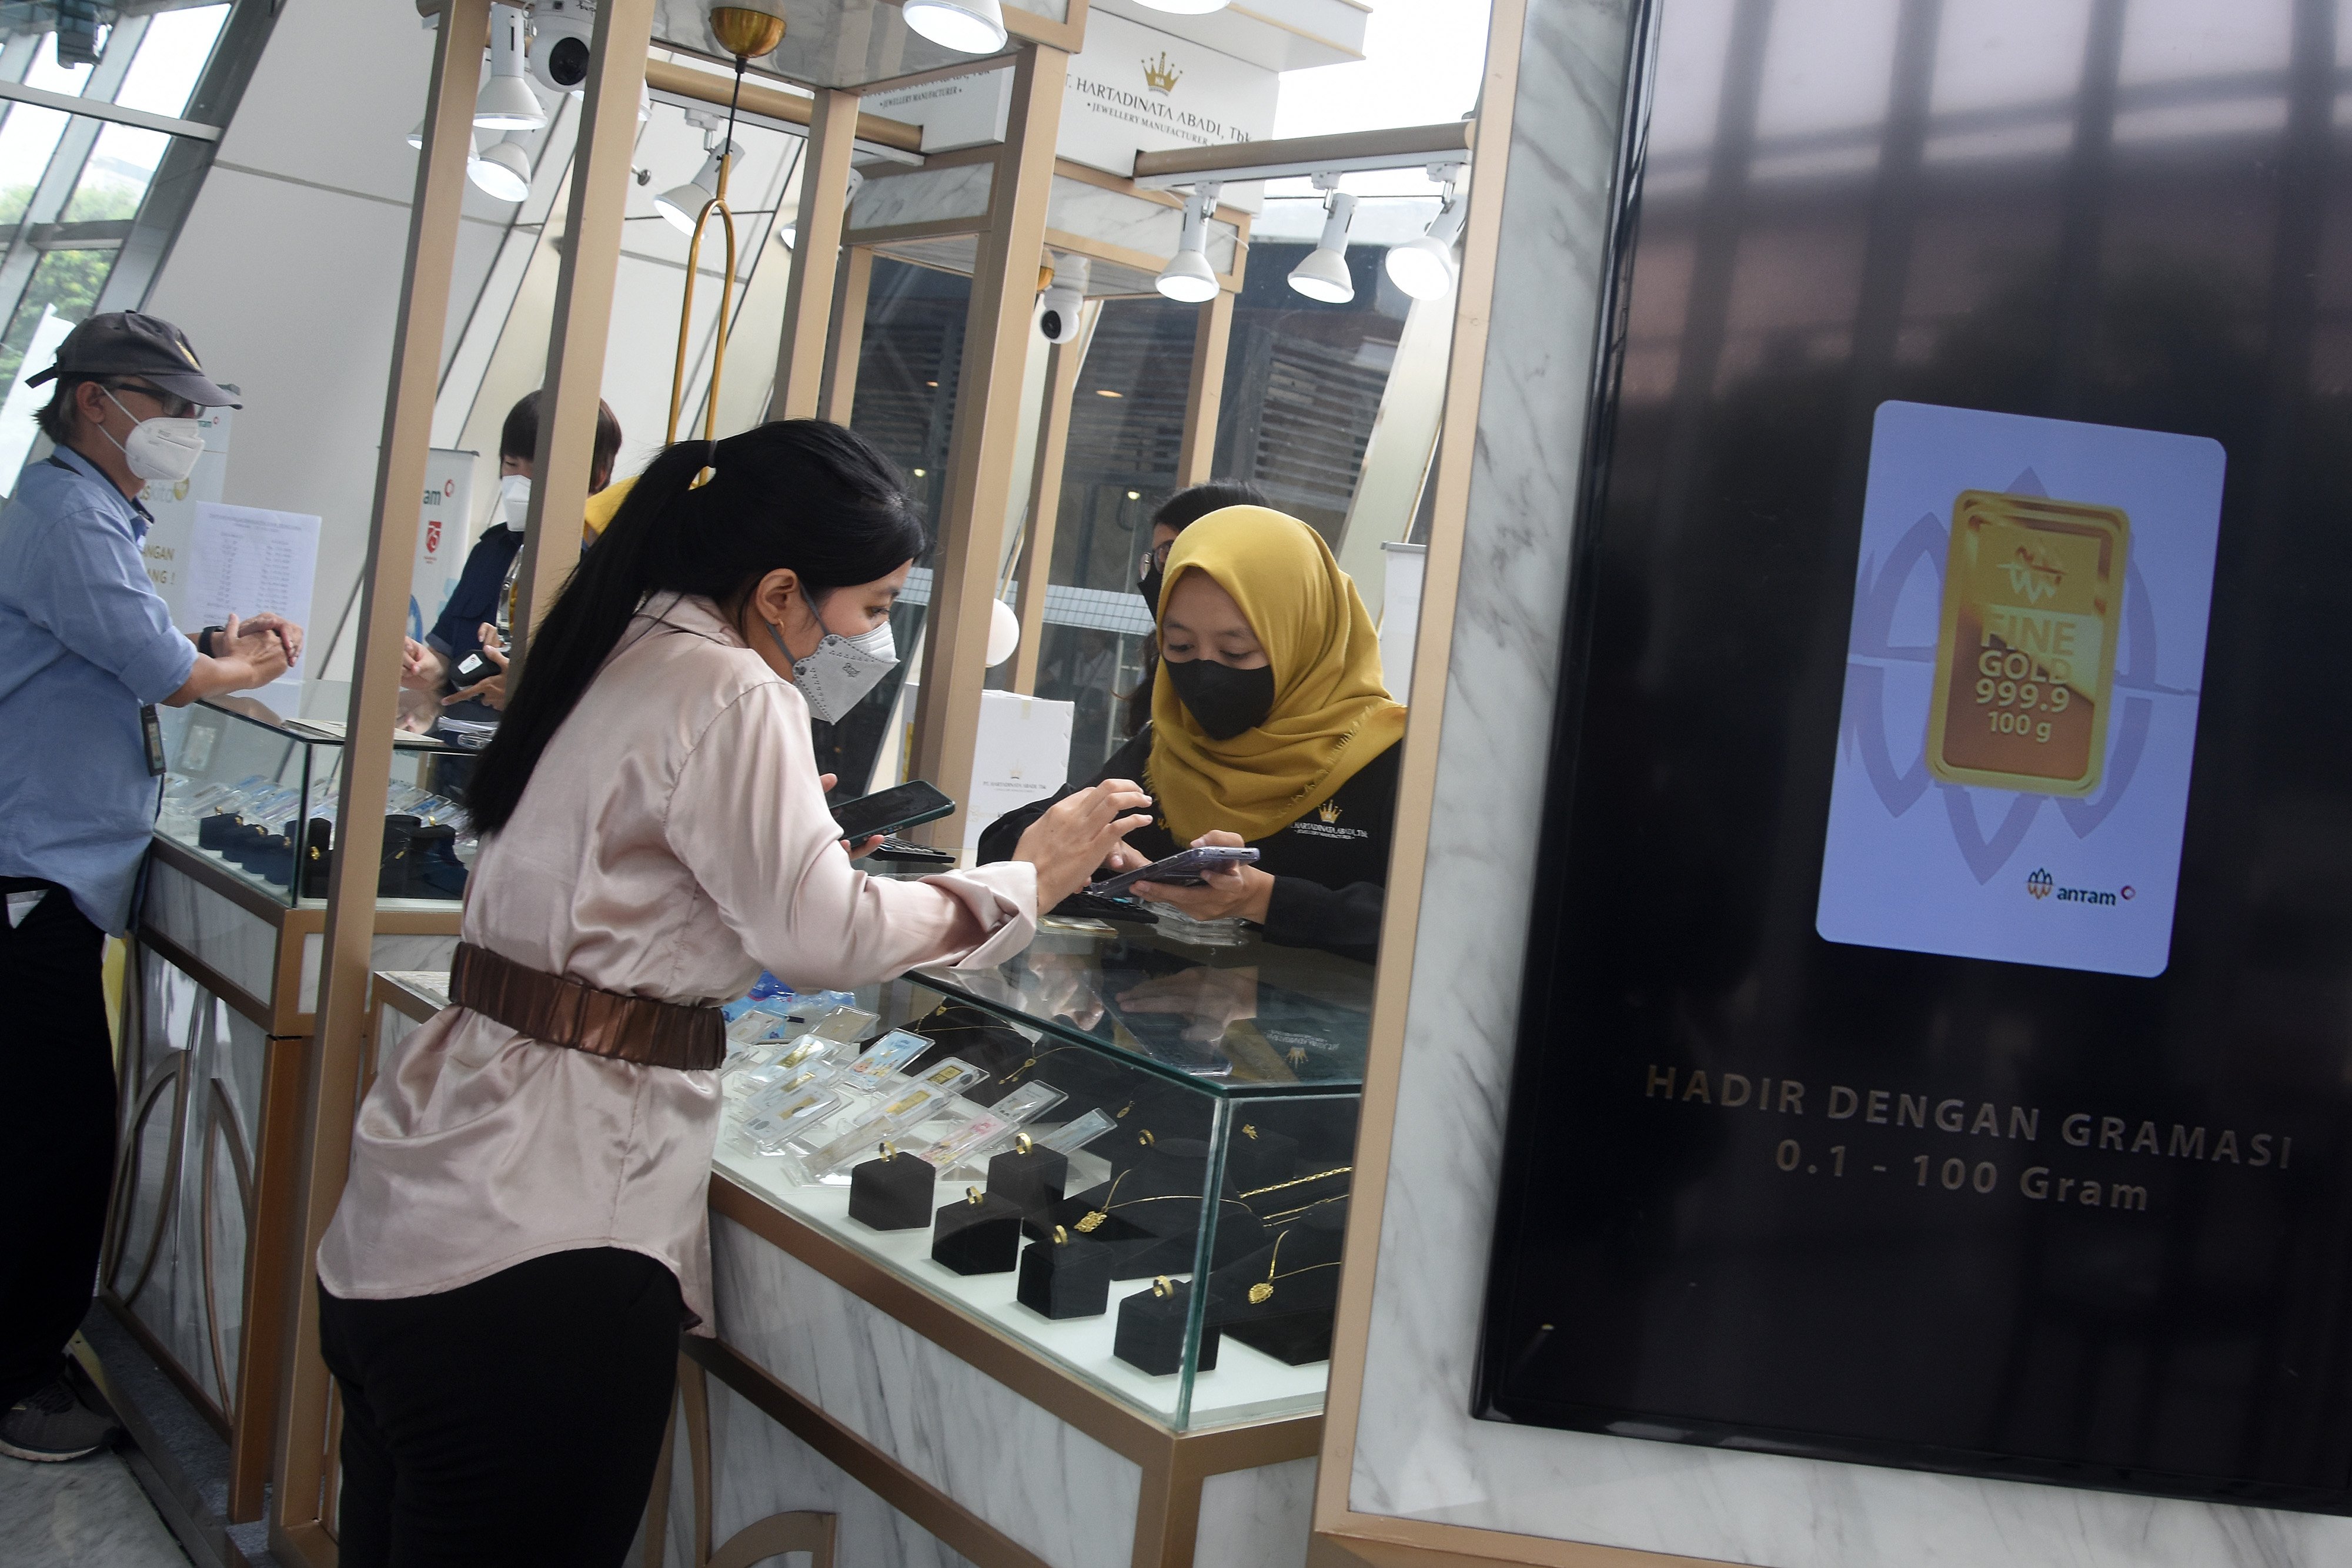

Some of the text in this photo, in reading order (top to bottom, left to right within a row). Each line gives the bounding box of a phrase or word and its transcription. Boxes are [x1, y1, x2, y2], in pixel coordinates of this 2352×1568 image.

[1077, 77, 1172, 120] HARTADINATA
[1177, 112, 1224, 139] ABADI,
[1230, 126, 1252, 142] Tbk
[1093, 102, 1208, 145] JEWELLERY MANUFACTURER
[1981, 613, 2076, 656] FINE
[1978, 649, 2072, 685] GOLD
[1976, 678, 2070, 713] 999.9
[1988, 711, 2052, 743] 100 g
[2057, 887, 2116, 906] antam
[1645, 1064, 2292, 1169] HADIR DENGAN GRAMASI
[1776, 1139, 1846, 1176] 0.1
[1913, 1154, 1997, 1194] 100
[2020, 1166, 2147, 1210] Gram
